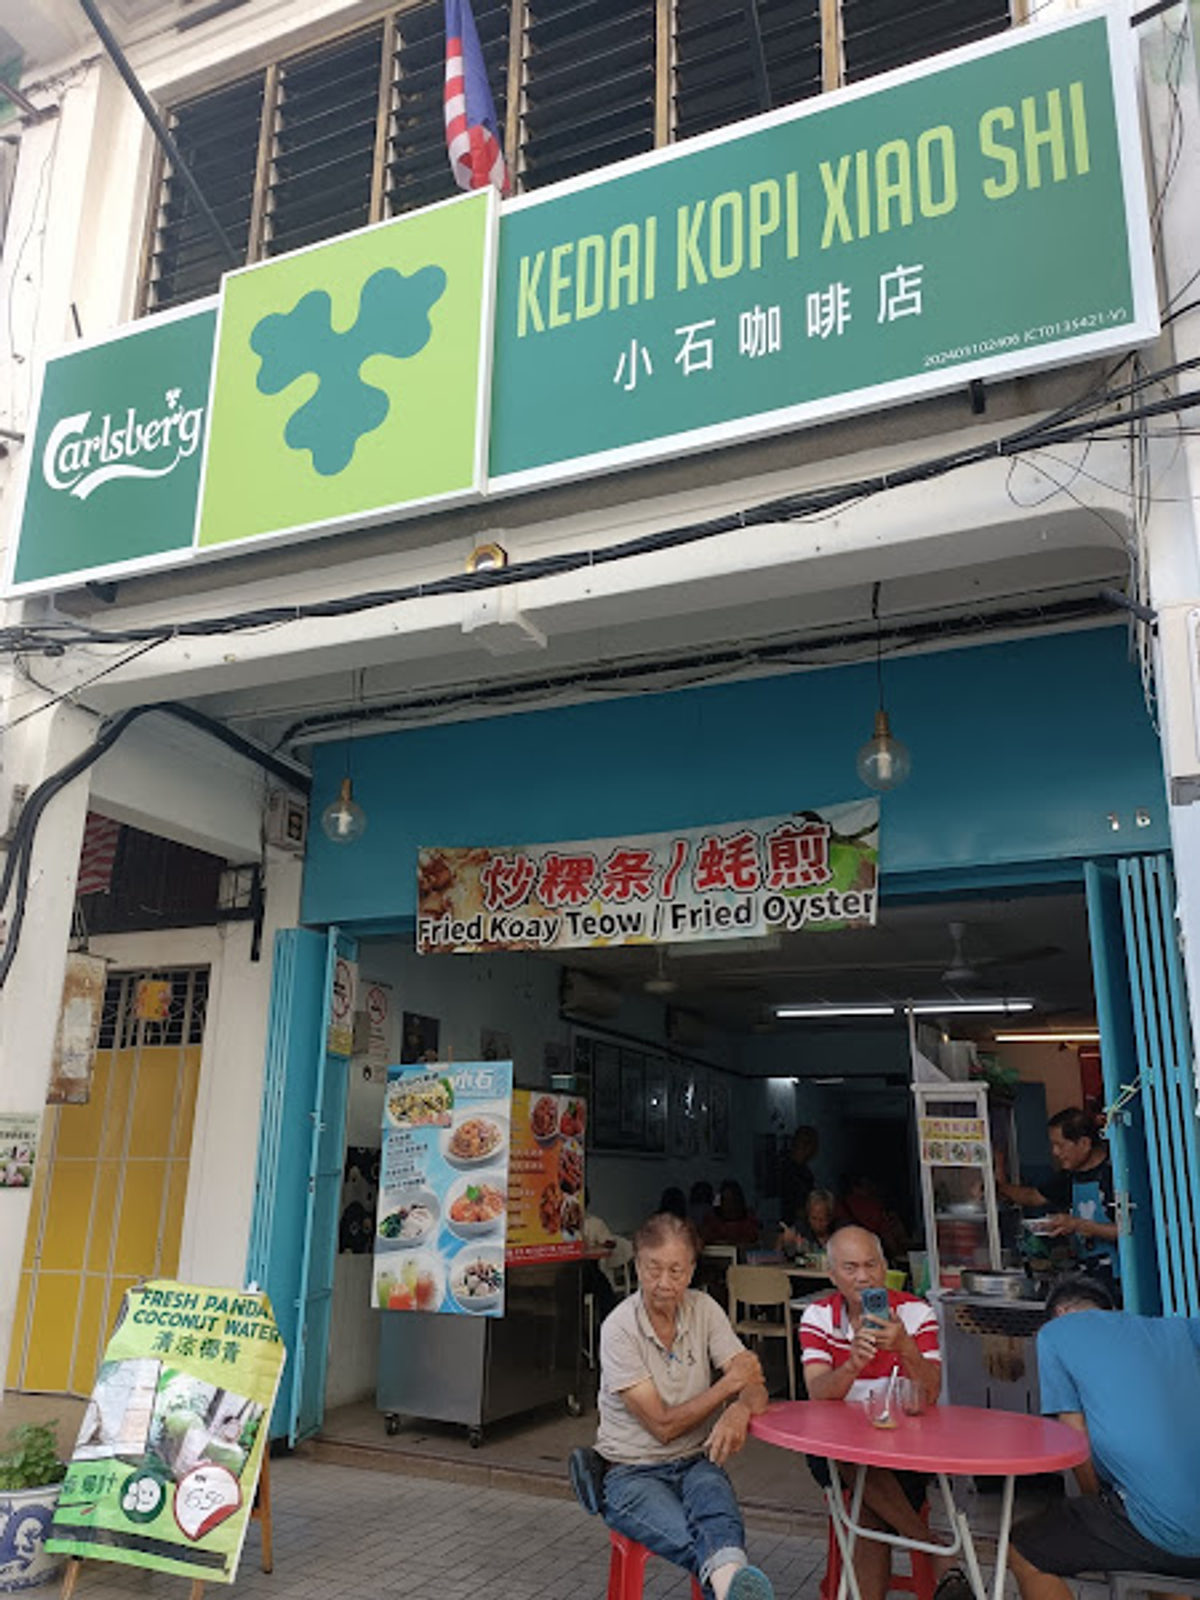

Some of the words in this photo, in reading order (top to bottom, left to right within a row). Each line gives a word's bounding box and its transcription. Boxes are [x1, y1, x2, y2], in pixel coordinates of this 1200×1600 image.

[516, 214, 657, 338] KEDAI
[677, 170, 799, 292] KOPI
[818, 124, 958, 249] XIAO
[978, 81, 1091, 202] SHI
[612, 263, 925, 391] 小石咖啡店
[43, 398, 204, 497] Carlsberg
[418, 912, 482, 945] Fried
[490, 916, 560, 944] Koay
[565, 907, 643, 937] Teow
[671, 898, 753, 930] Fried
[762, 889, 875, 928] Oyster
[133, 1309, 219, 1333] COCONUT
[224, 1319, 282, 1343] WATER
[140, 1289, 200, 1311] FRESH
